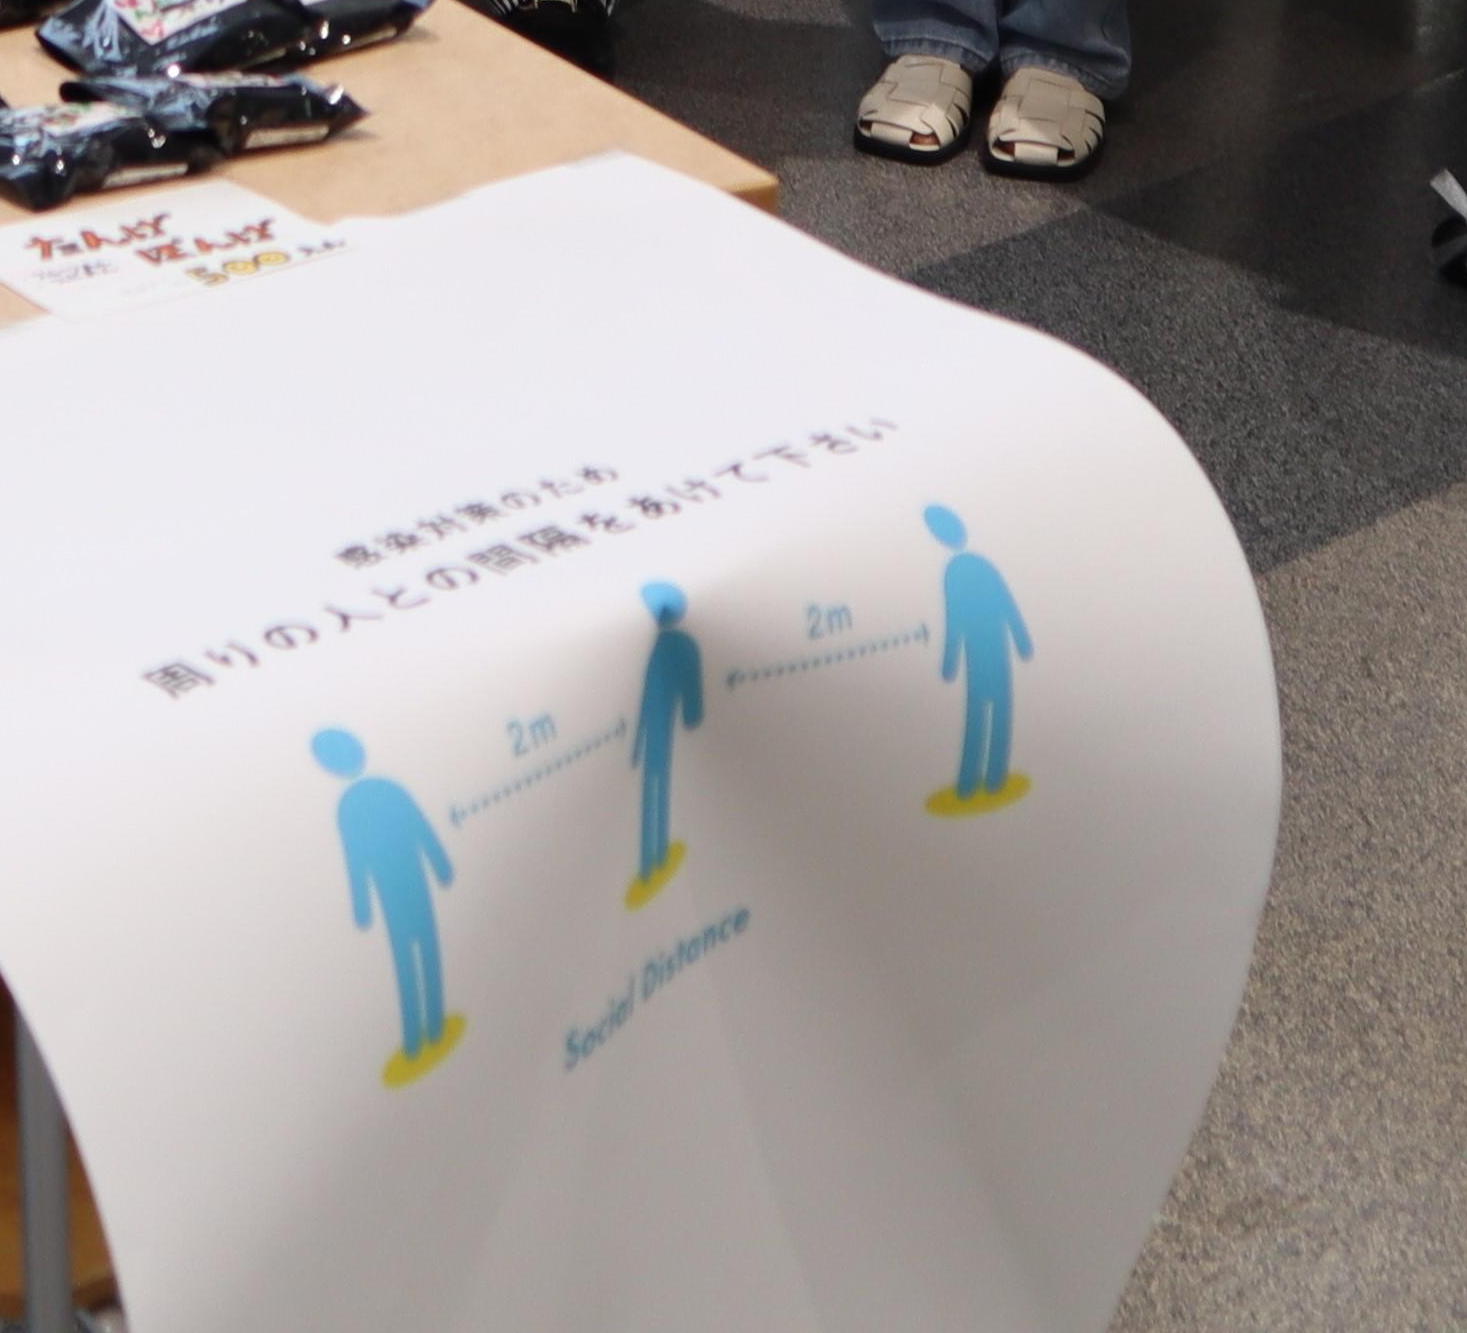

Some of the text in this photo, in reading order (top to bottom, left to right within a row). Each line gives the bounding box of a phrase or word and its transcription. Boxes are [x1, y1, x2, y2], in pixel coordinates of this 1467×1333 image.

[139, 415, 900, 700] 周りの人との間隔をあけて下さい
[334, 462, 622, 570] 感染対策のため
[804, 601, 854, 643] 2m
[506, 713, 559, 757] 2m
[560, 905, 754, 1072] Social Distance
